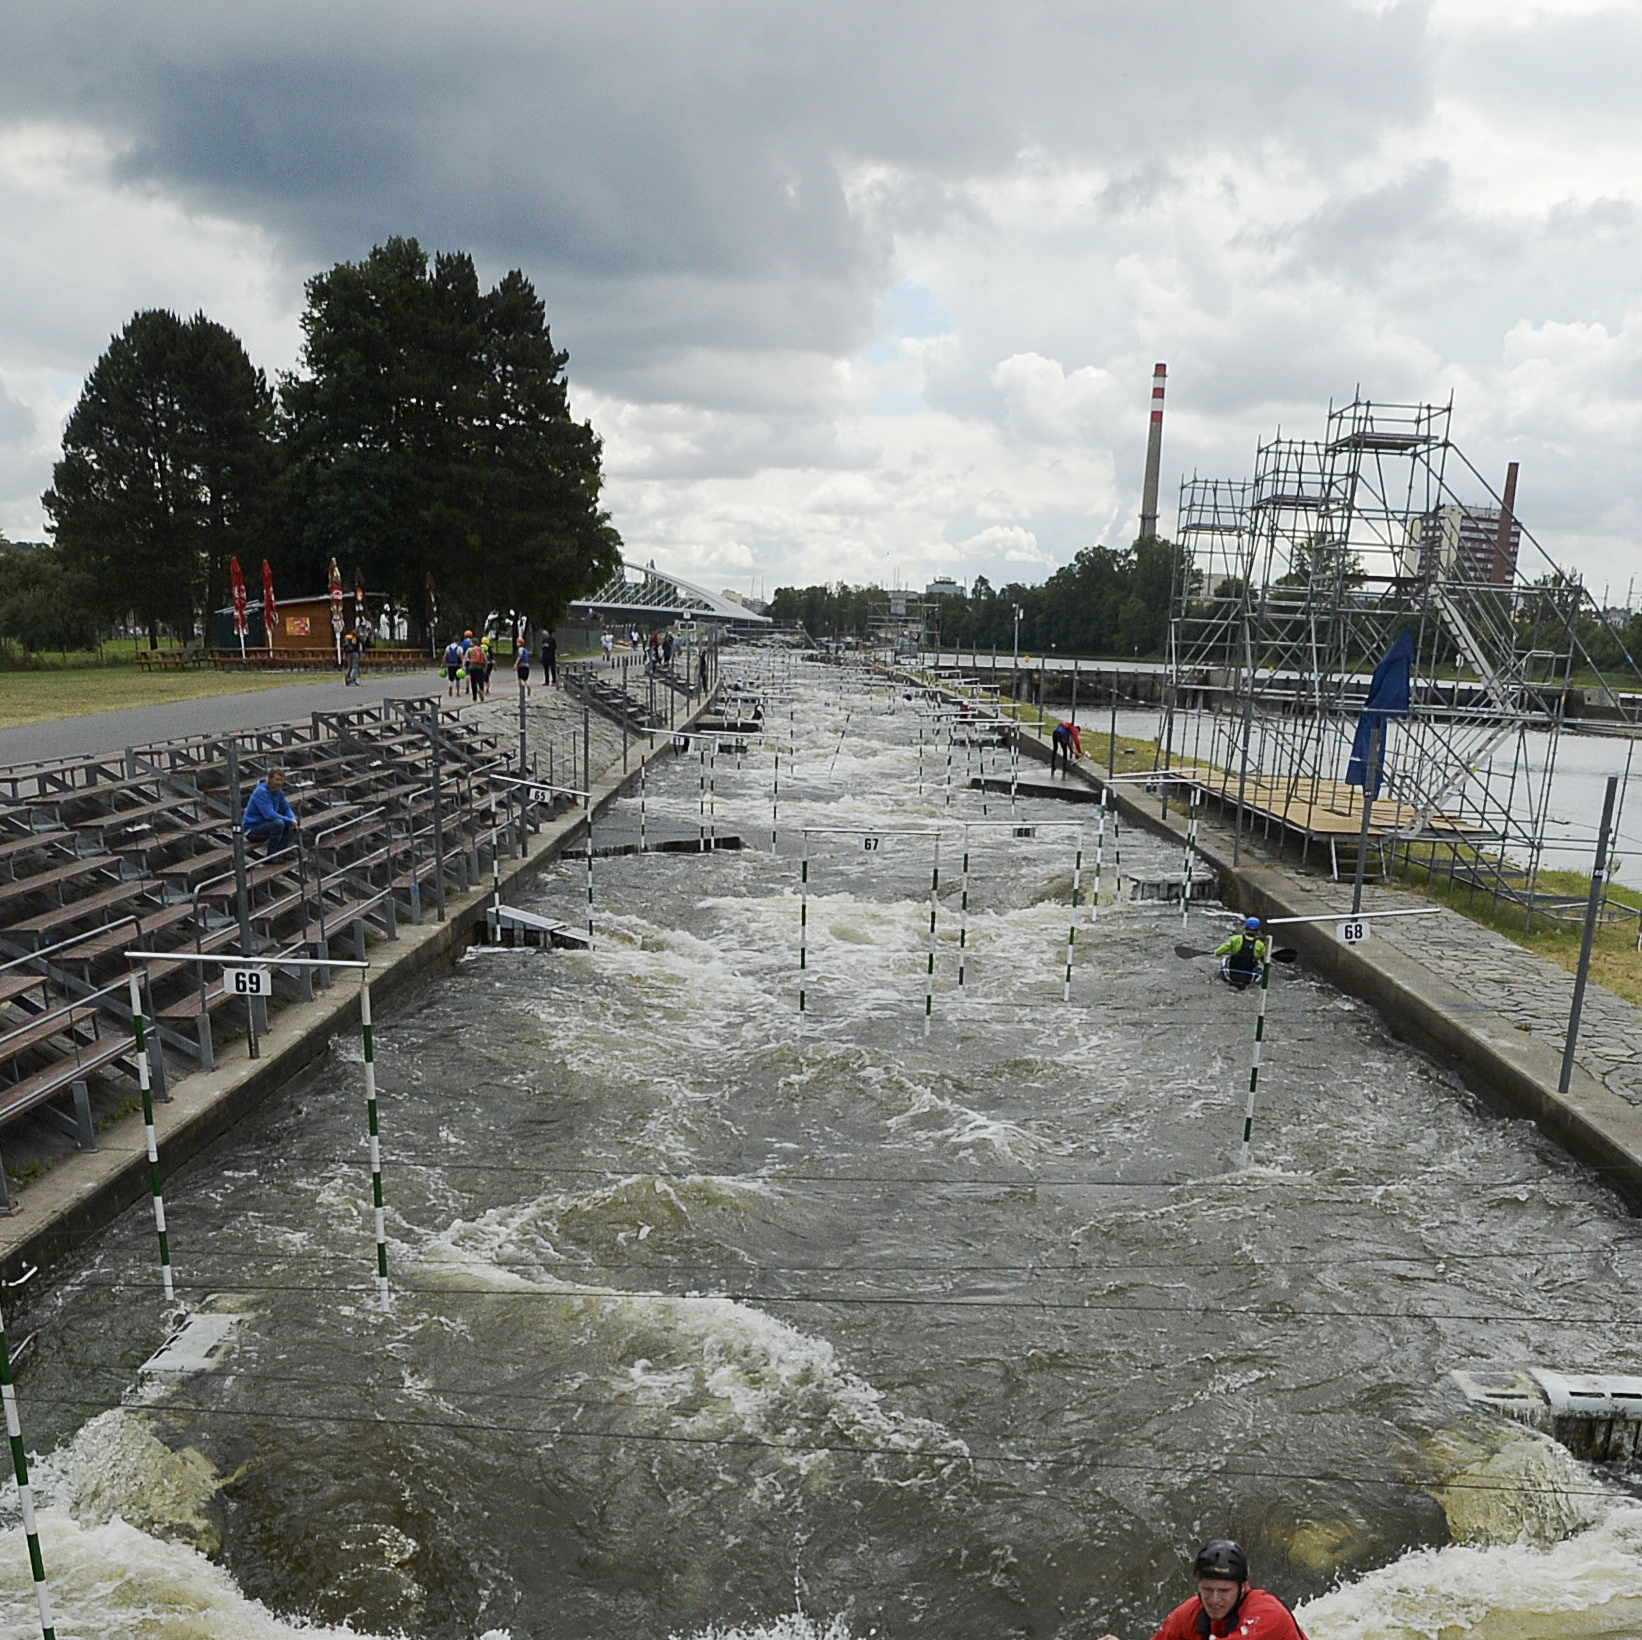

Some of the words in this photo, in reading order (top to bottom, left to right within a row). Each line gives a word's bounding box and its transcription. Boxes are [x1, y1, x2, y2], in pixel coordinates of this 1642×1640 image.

[534, 790, 546, 802] 65
[864, 838, 879, 851] 67
[1344, 924, 1363, 940] 68
[235, 972, 261, 993] 69
